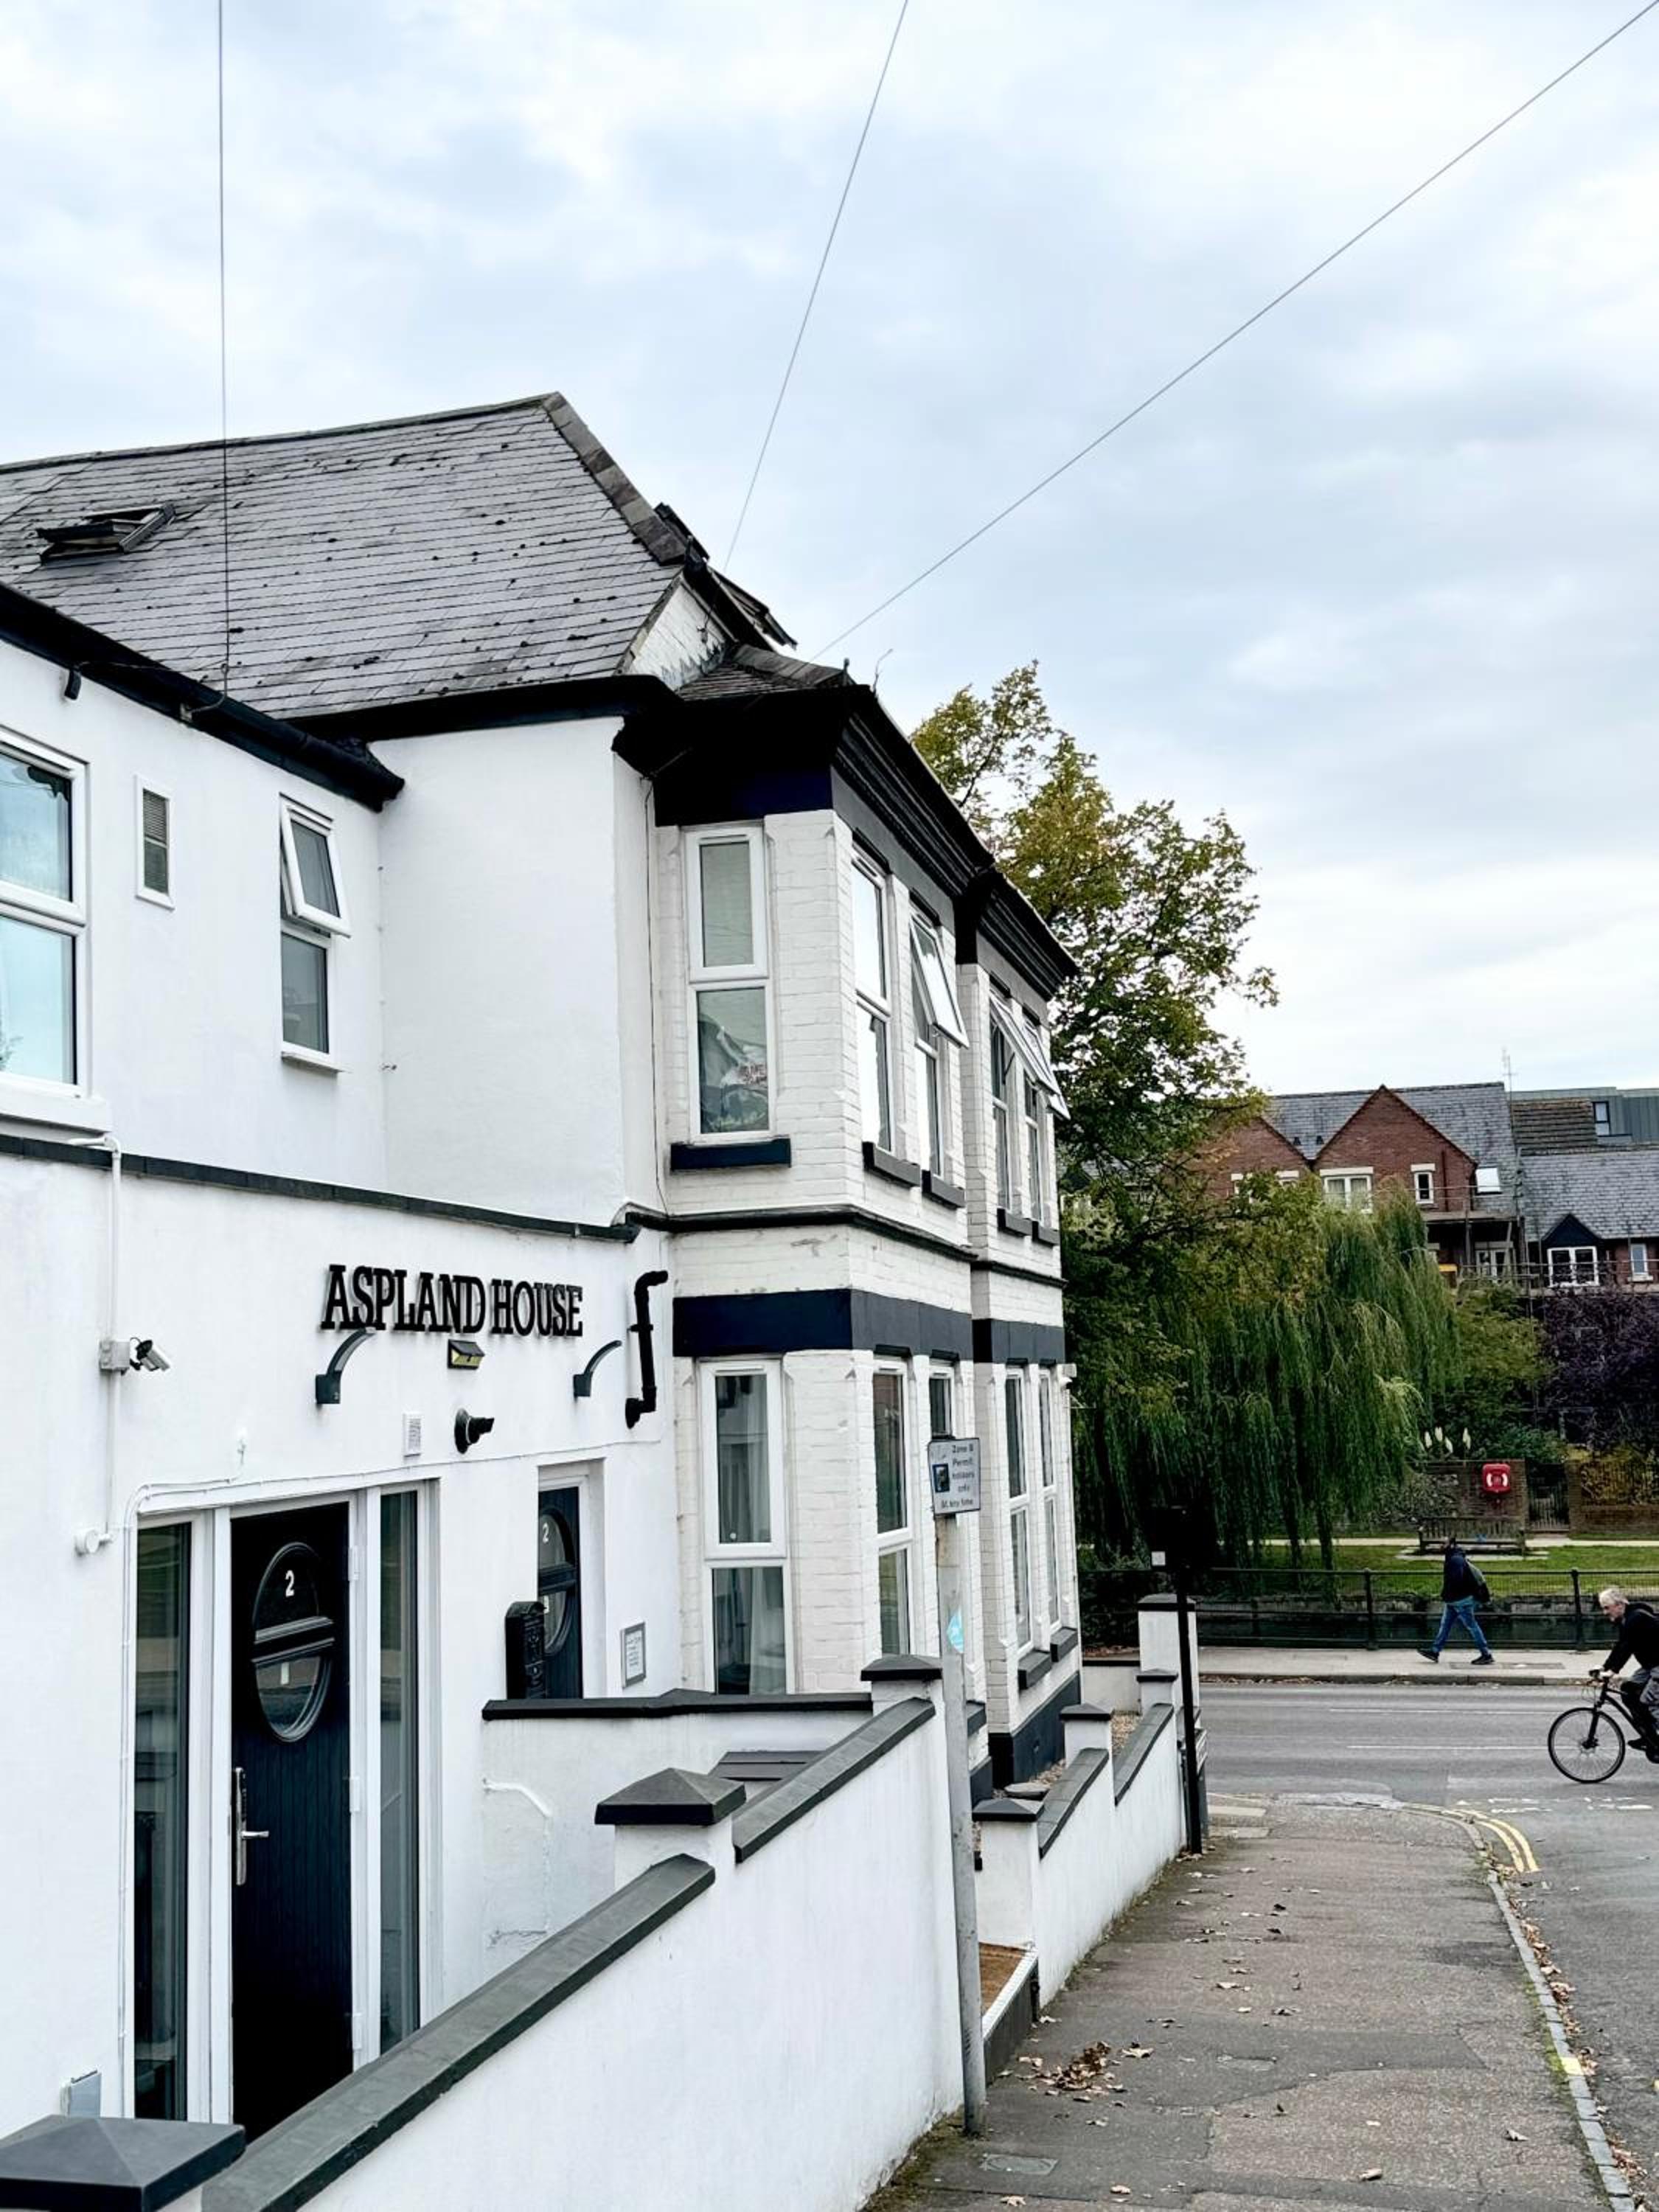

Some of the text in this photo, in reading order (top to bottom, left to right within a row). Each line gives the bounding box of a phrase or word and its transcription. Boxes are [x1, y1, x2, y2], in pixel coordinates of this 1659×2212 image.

[320, 1265, 583, 1336] ASPLAND HOUSE
[542, 1522, 549, 1543] 2
[285, 1569, 295, 1597] 2
